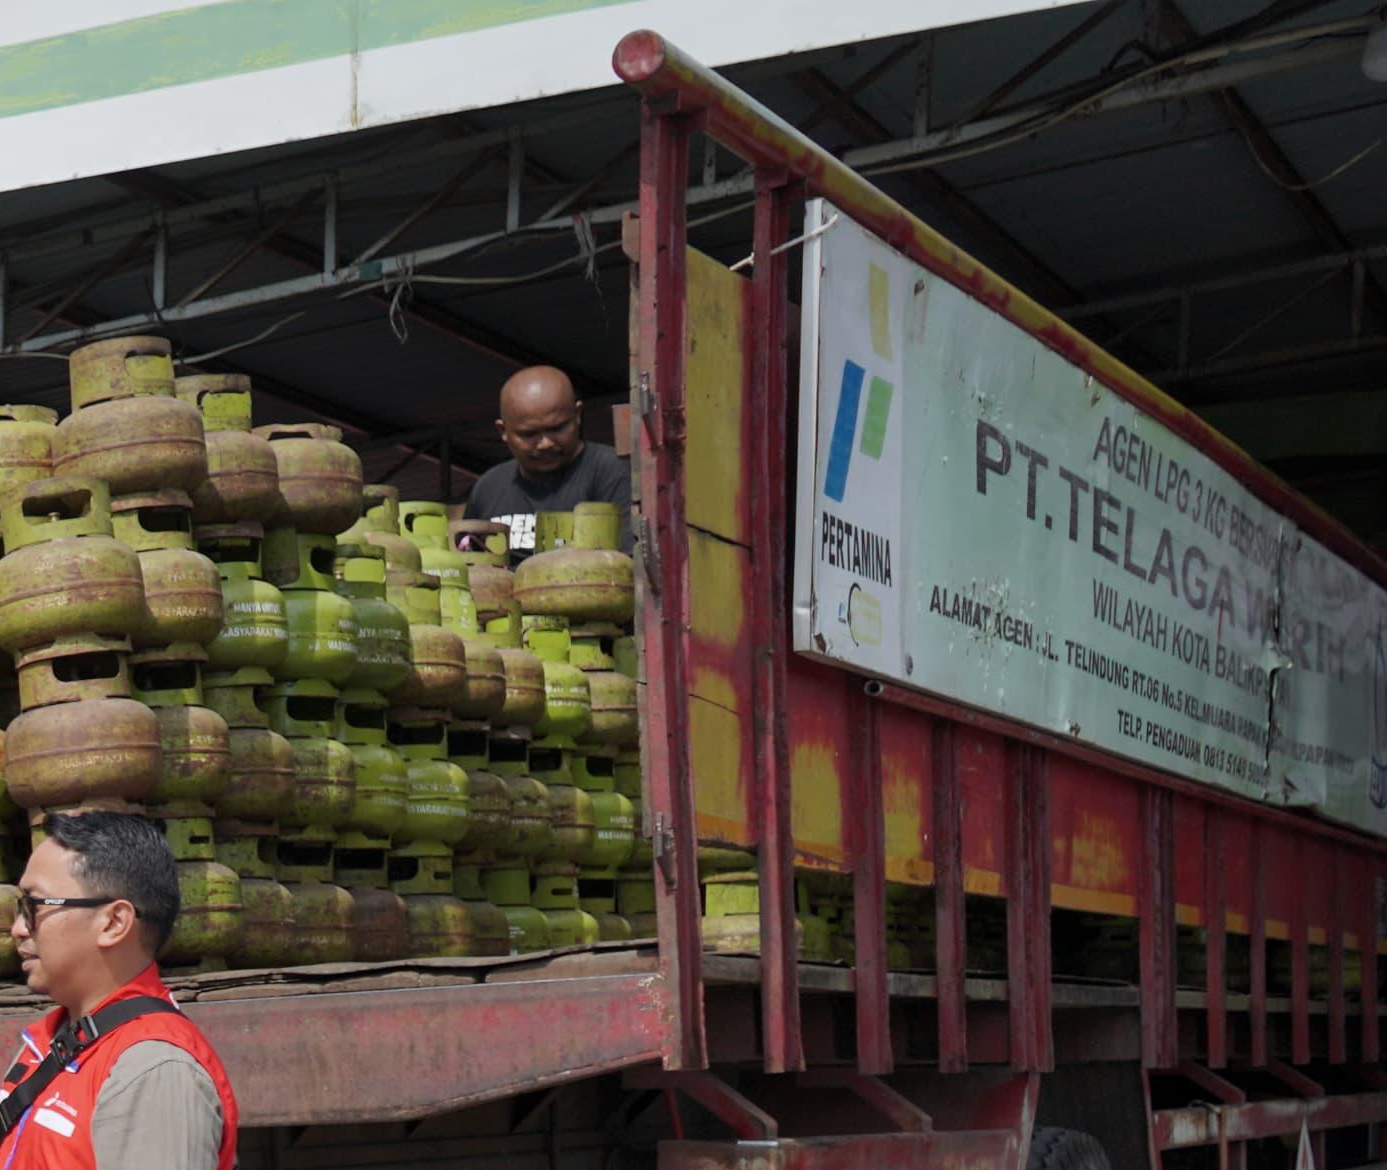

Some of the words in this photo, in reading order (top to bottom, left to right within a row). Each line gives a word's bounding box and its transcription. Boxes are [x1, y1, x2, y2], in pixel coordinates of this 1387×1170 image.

[1092, 417, 1152, 491] AGEN
[1154, 452, 1191, 514] LPG
[1192, 480, 1203, 523] 3
[1204, 488, 1226, 540] KG
[821, 511, 892, 588] PERTAMINA
[929, 585, 991, 632] ALAMAT
[994, 612, 1033, 650] AGEN
[1065, 640, 1129, 690] TELINDUNG
[1093, 579, 1168, 651] WILAYAH
[1172, 621, 1210, 675] KOTA
[1117, 710, 1142, 740] TELP.
[1146, 723, 1202, 763] PENGADUAN
